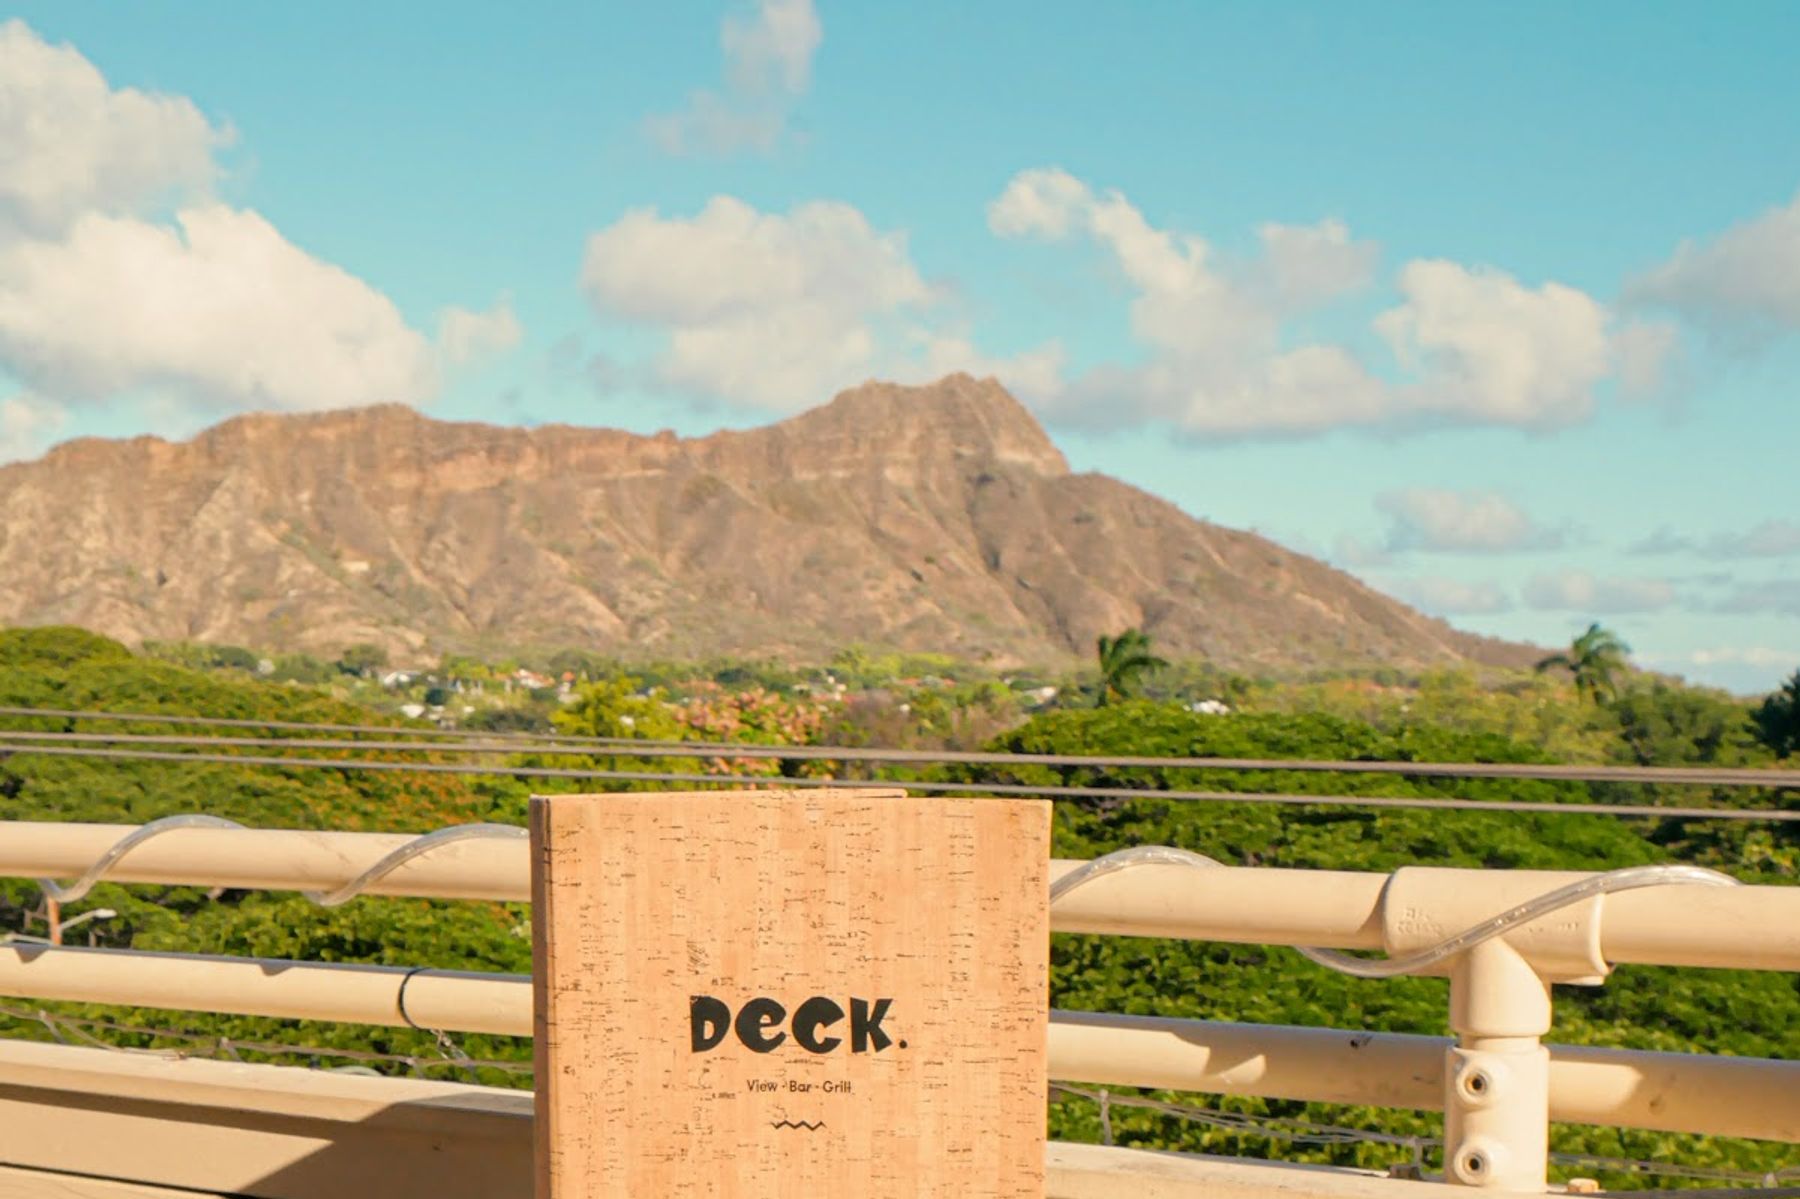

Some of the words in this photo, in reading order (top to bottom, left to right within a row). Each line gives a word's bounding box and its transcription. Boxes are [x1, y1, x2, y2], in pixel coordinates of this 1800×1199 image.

[746, 1079, 778, 1092] View
[789, 1080, 812, 1093] Bar
[822, 1080, 852, 1093] Grill
